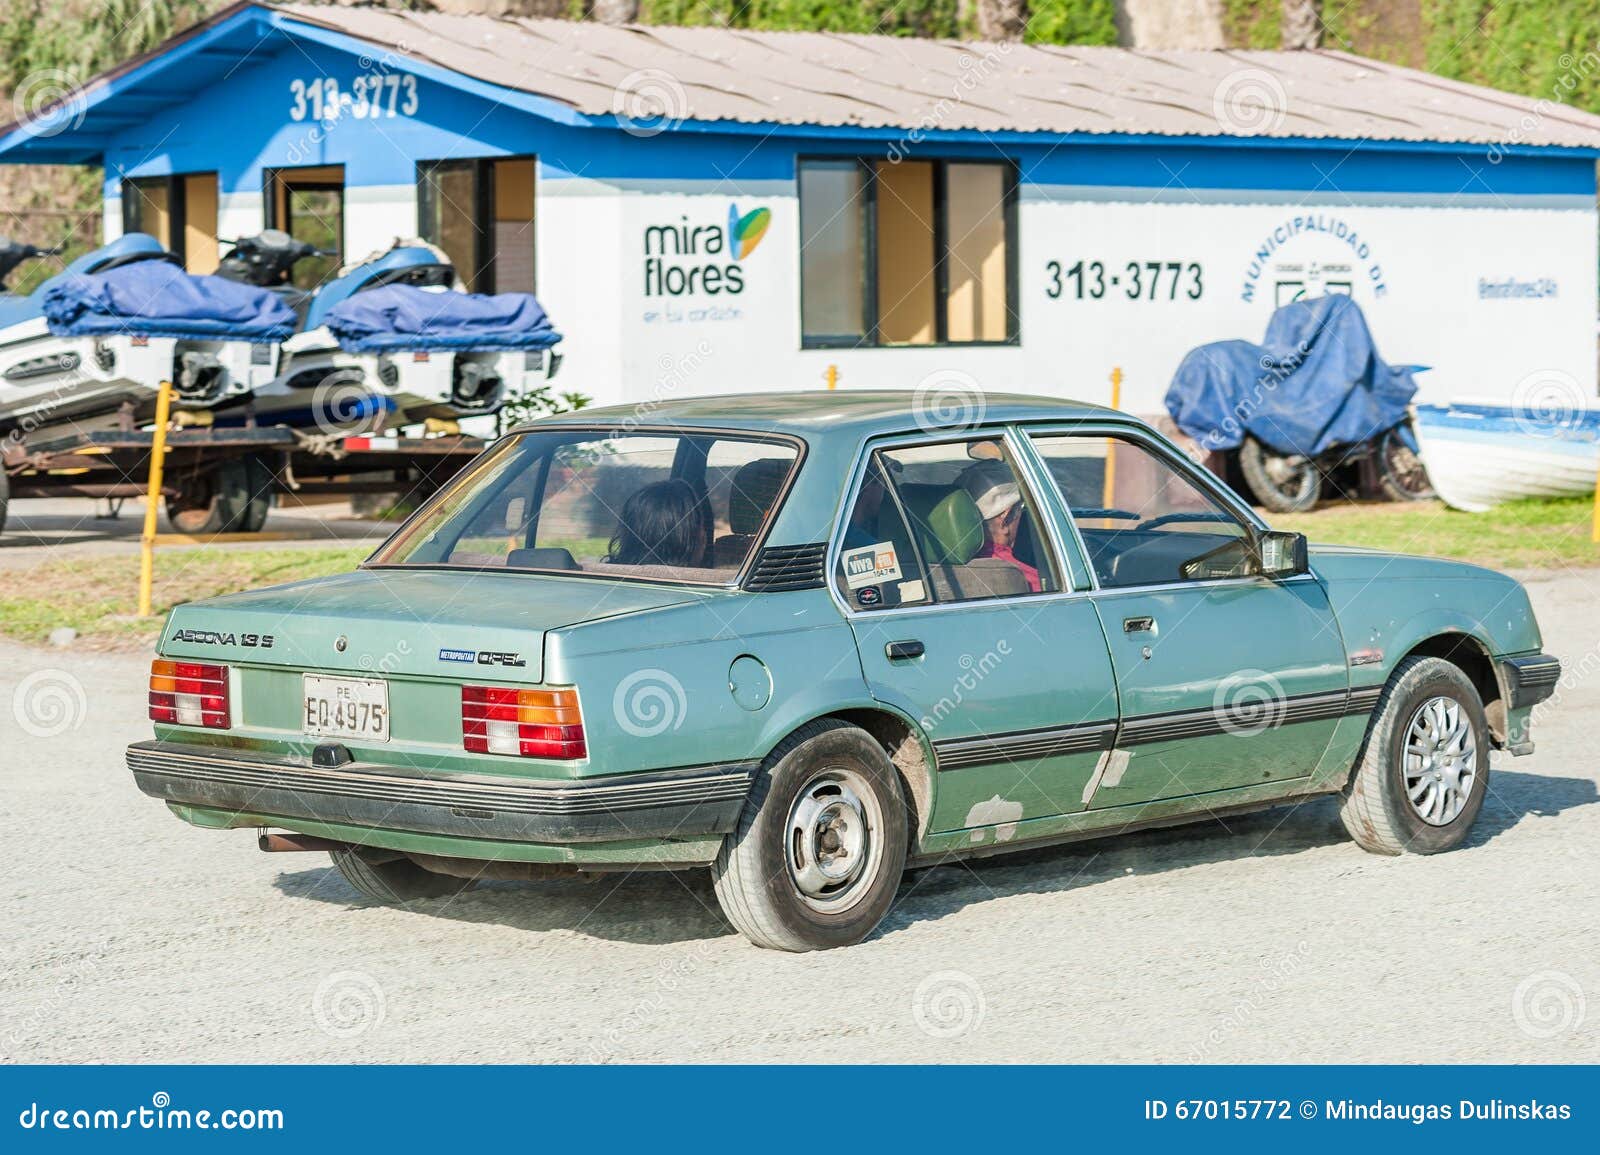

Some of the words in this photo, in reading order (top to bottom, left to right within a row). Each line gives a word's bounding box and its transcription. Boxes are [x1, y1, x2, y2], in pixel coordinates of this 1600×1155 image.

[645, 215, 723, 255] mira
[1241, 214, 1369, 303] MUNICIPALIDAD
[1369, 265, 1387, 298] DE
[645, 258, 744, 296] flores
[172, 629, 236, 646] ASCONA
[261, 635, 274, 648] S
[478, 651, 526, 667] OPEL
[336, 687, 351, 699] PE
